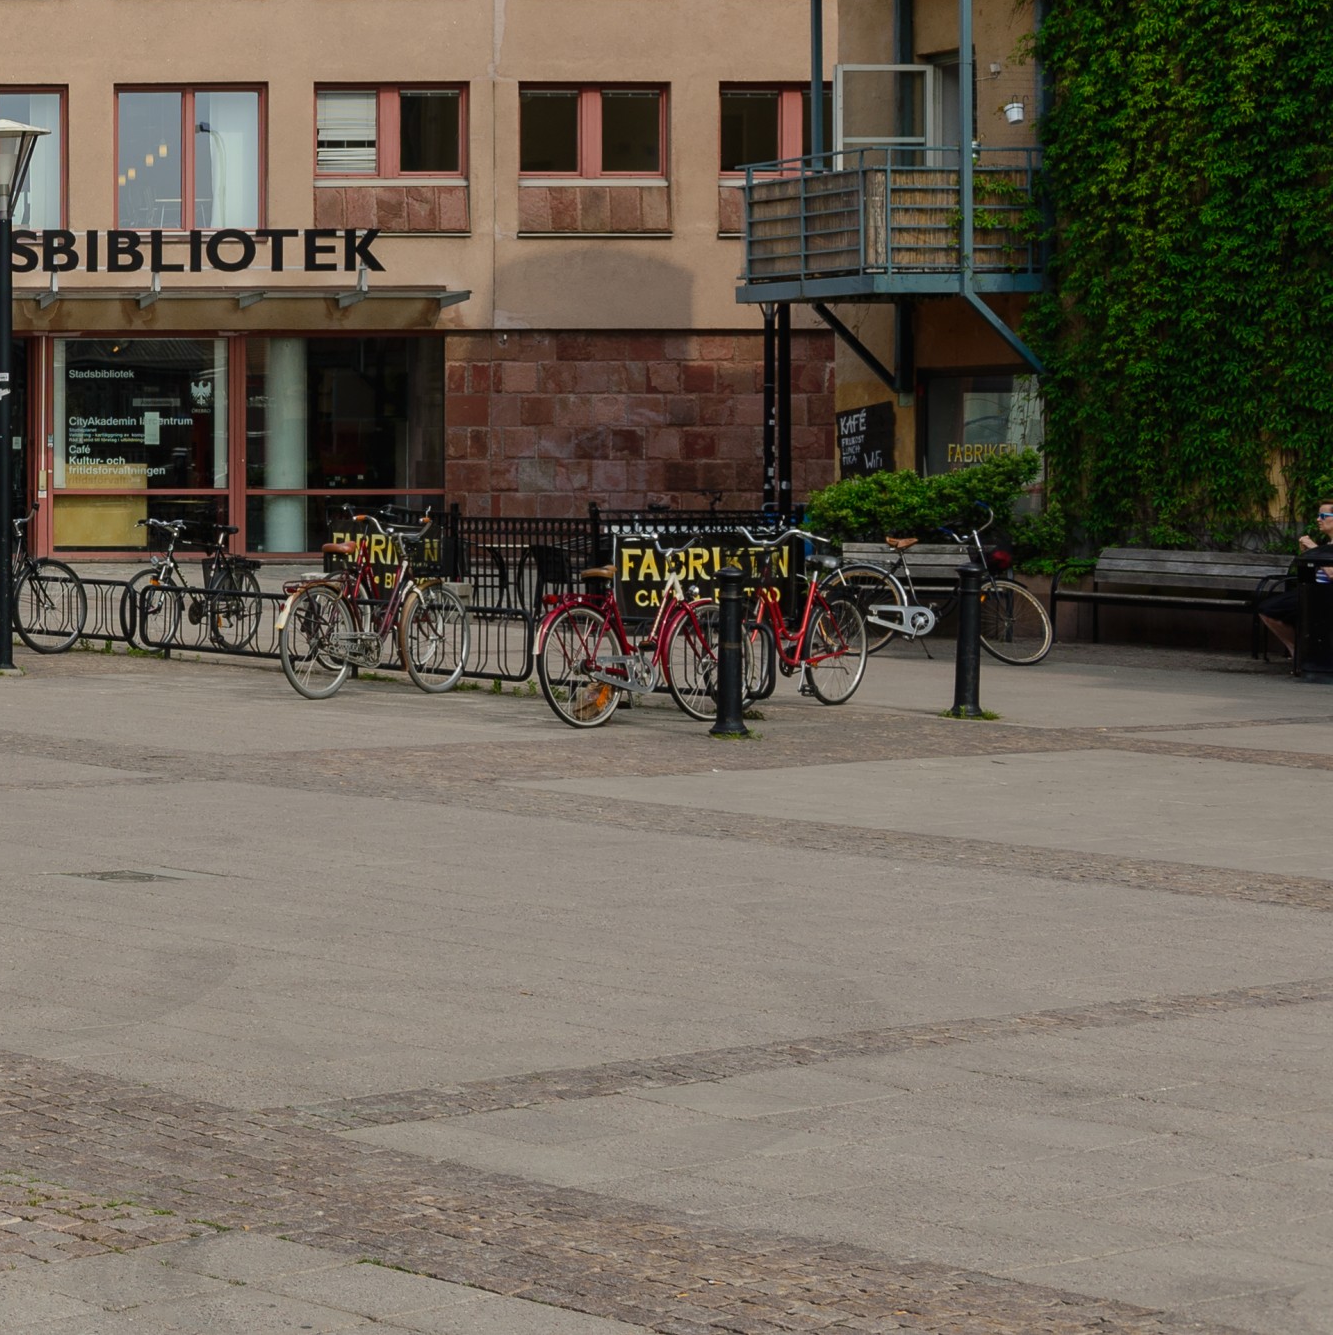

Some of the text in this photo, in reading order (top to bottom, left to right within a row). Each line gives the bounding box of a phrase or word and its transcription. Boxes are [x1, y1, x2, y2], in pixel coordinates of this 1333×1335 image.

[68, 369, 135, 379] Stadsbibliotek
[68, 416, 137, 428] CityAkademin
[840, 408, 866, 435] KAFÉ
[68, 444, 91, 454] Café
[68, 456, 126, 465] Kultur- och
[68, 466, 166, 477] fritidsförvaltningen
